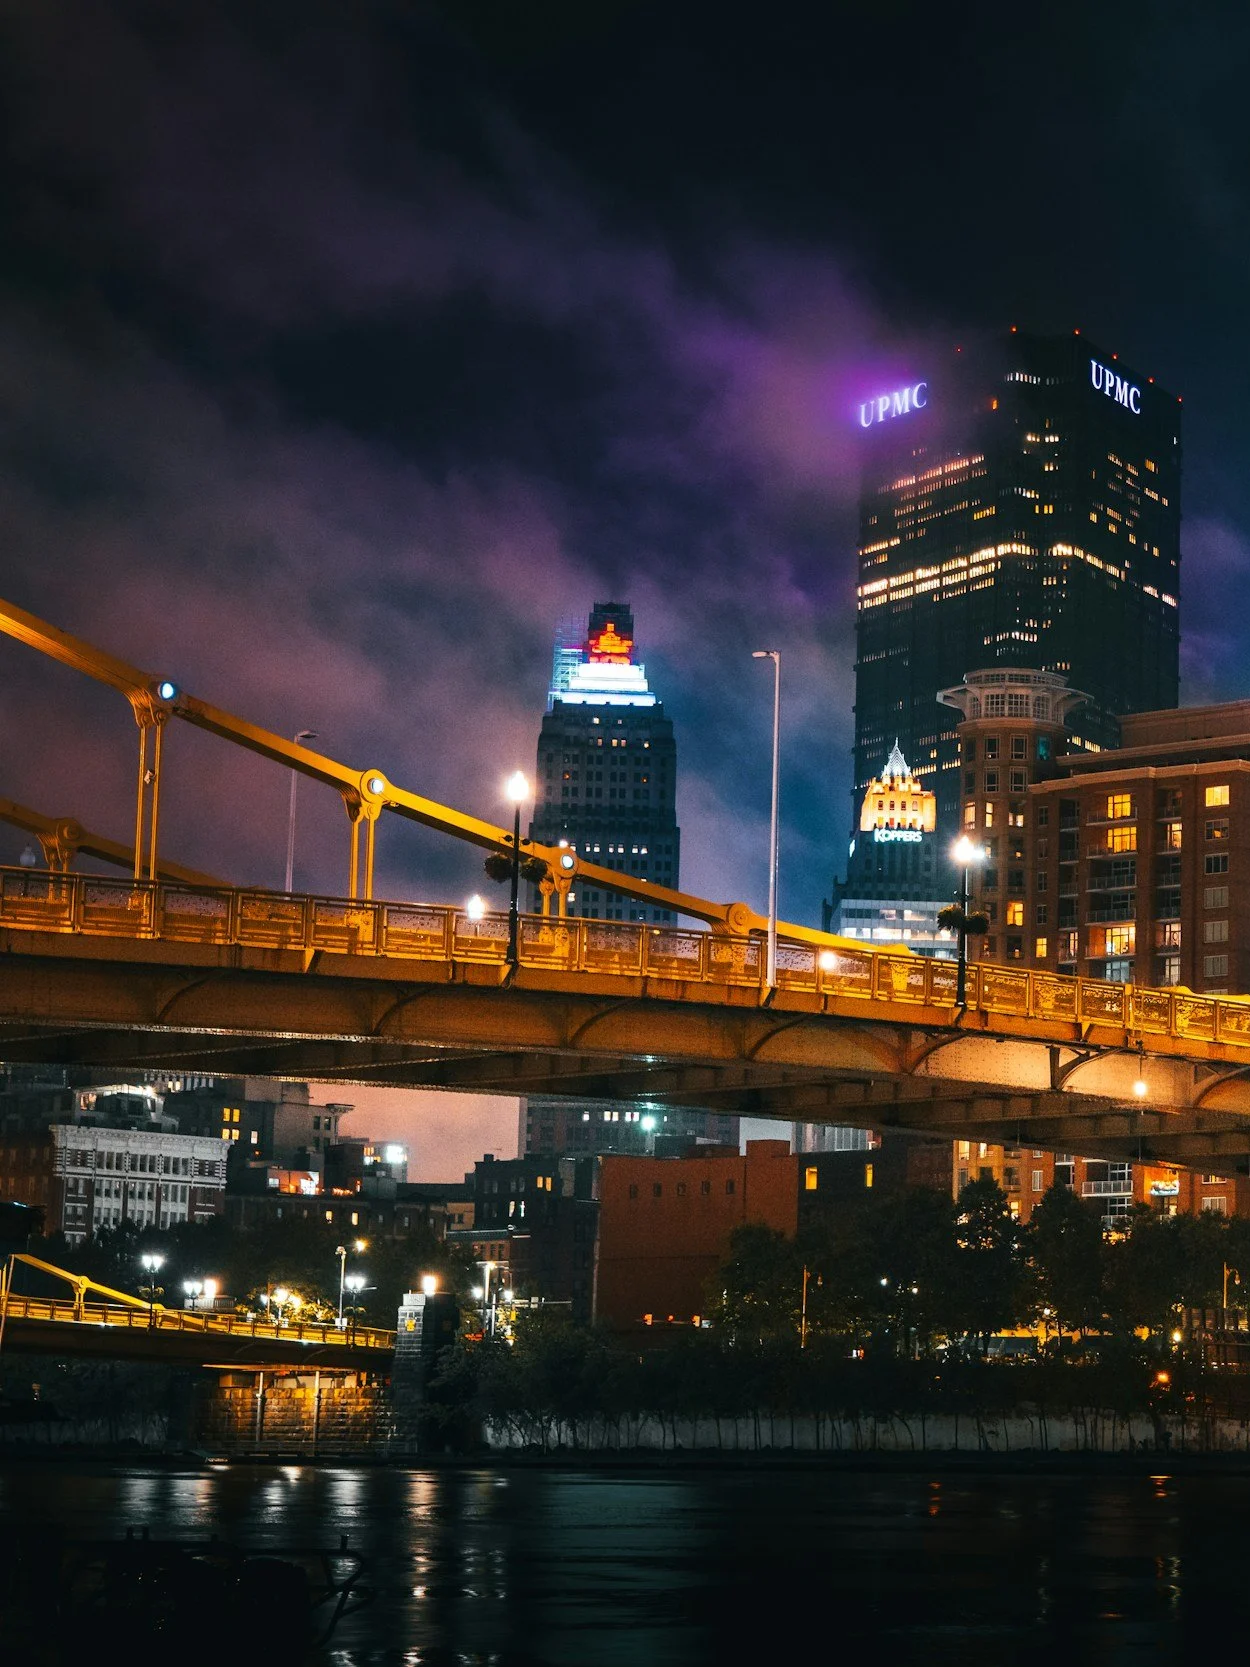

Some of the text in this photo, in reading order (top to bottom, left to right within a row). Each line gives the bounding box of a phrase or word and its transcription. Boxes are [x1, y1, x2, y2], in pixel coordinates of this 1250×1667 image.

[859, 382, 928, 428] UPMC
[1090, 358, 1141, 415] UPMC
[875, 829, 922, 842] KOPPERS
